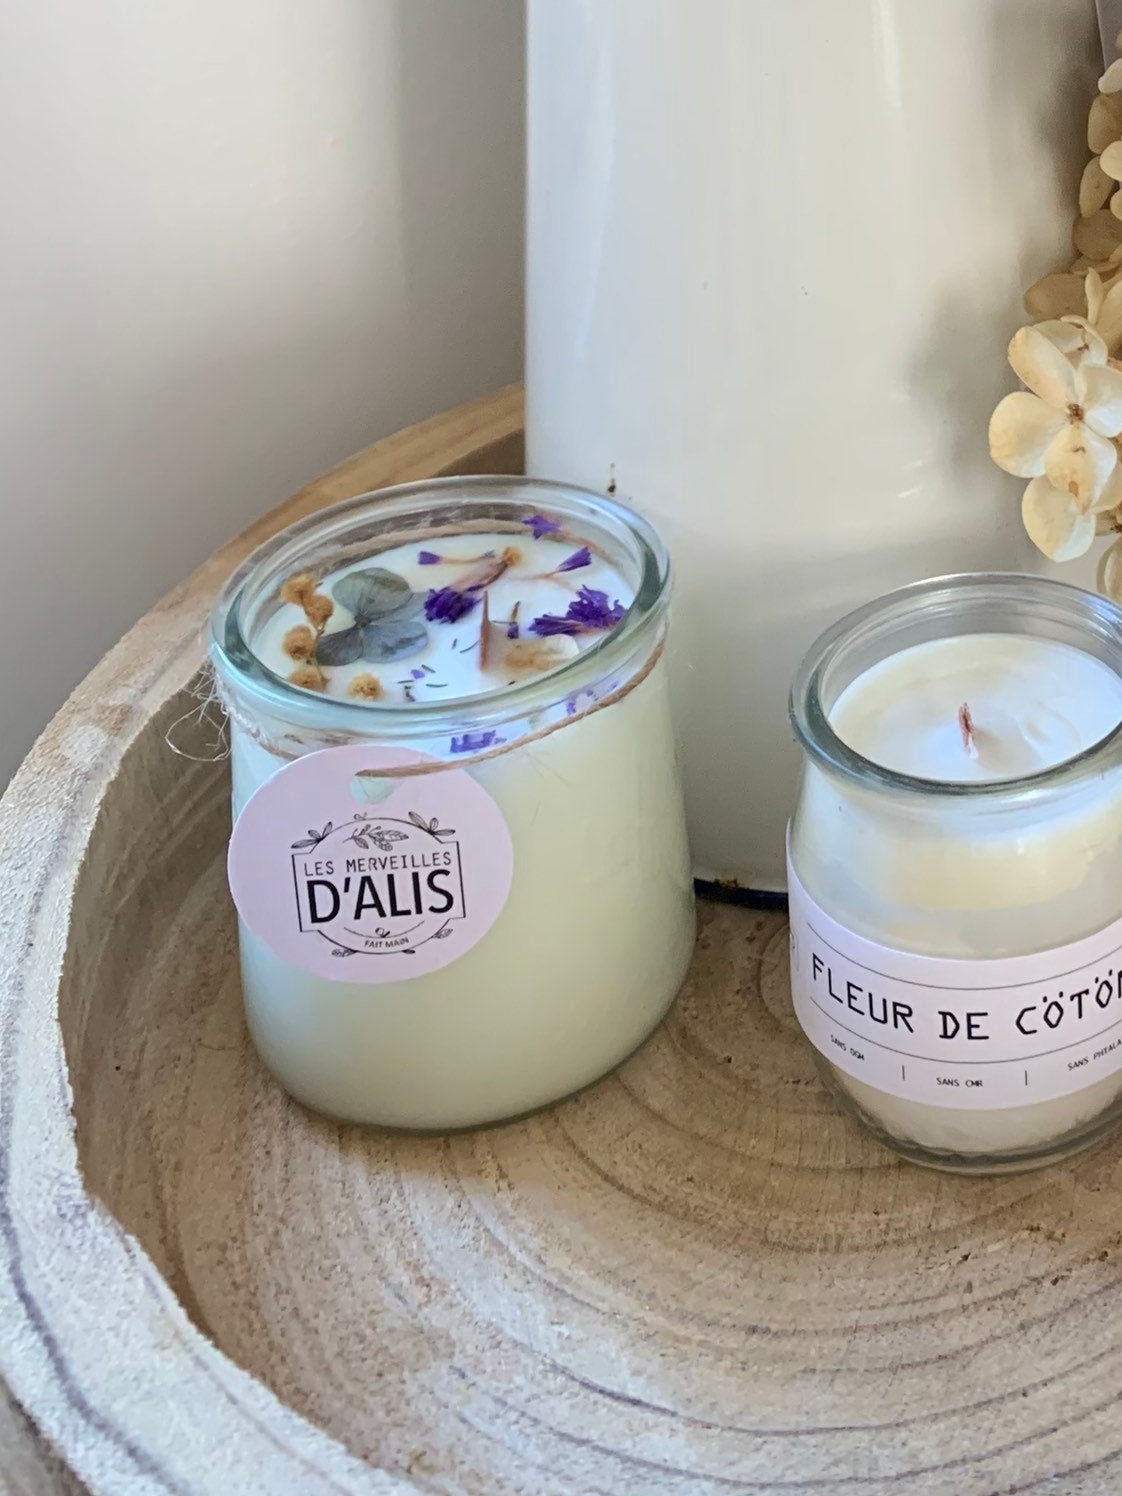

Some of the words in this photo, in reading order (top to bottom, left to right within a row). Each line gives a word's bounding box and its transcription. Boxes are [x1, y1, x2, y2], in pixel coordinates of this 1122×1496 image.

[303, 861, 334, 877] LES
[346, 851, 452, 873] MERVEILLES
[305, 868, 455, 924] D'ALIS
[364, 939, 383, 949] FAIT
[385, 937, 410, 949] MAIN
[812, 952, 915, 1033] FLEUR
[937, 1010, 990, 1041] DE
[1067, 1056, 1089, 1071] SANS
[936, 1077, 960, 1087] SANS
[965, 1079, 984, 1087] CMR
